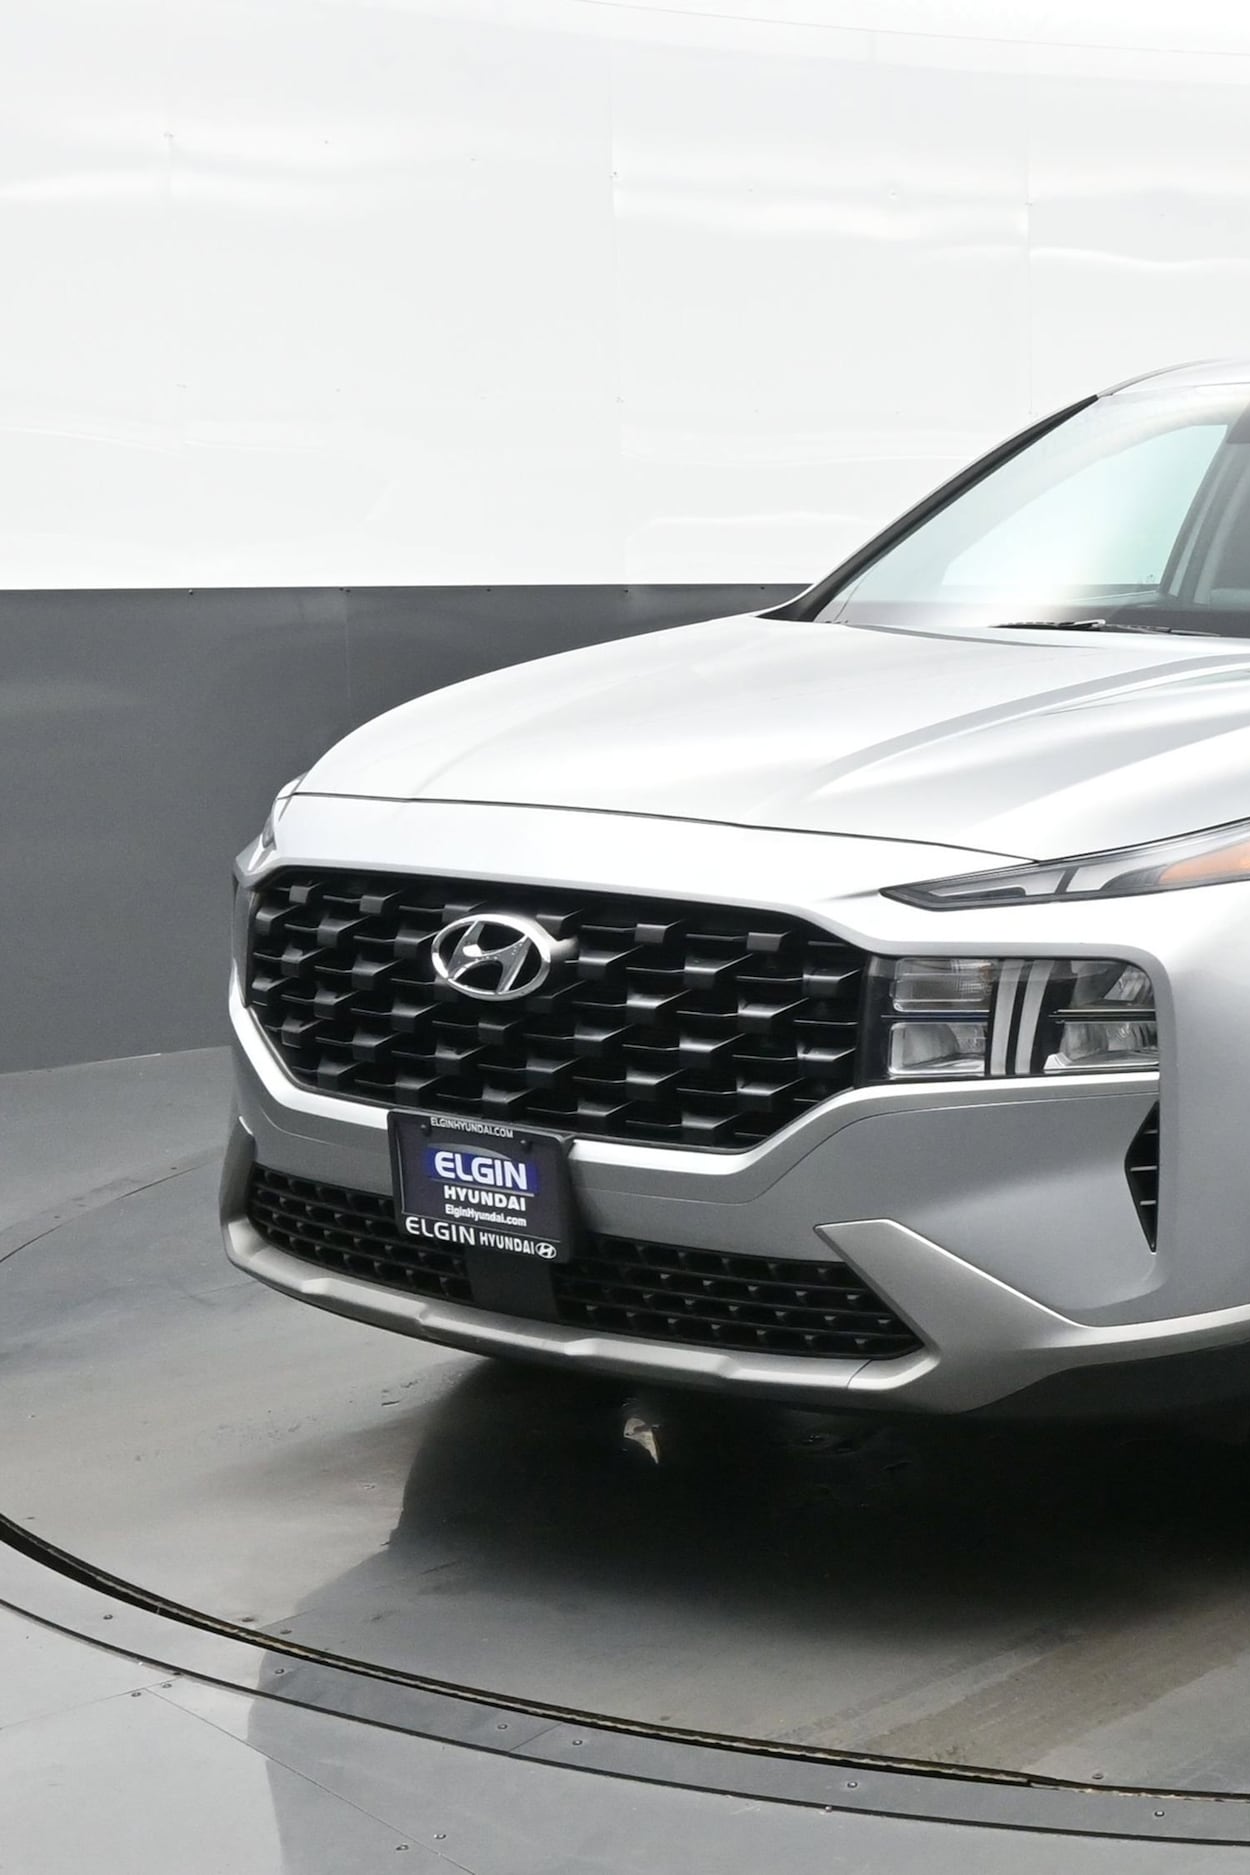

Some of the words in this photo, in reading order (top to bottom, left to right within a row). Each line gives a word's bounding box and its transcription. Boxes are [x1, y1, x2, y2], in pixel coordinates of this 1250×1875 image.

[430, 1117, 514, 1139] ELGINHYUNDAI.COM
[434, 1150, 528, 1191] ELGIN
[443, 1185, 526, 1211] HYUNDAI
[445, 1204, 527, 1228] ElginHyundai.com
[405, 1216, 475, 1246] ELGIN
[479, 1231, 535, 1256] HYUNDAI
